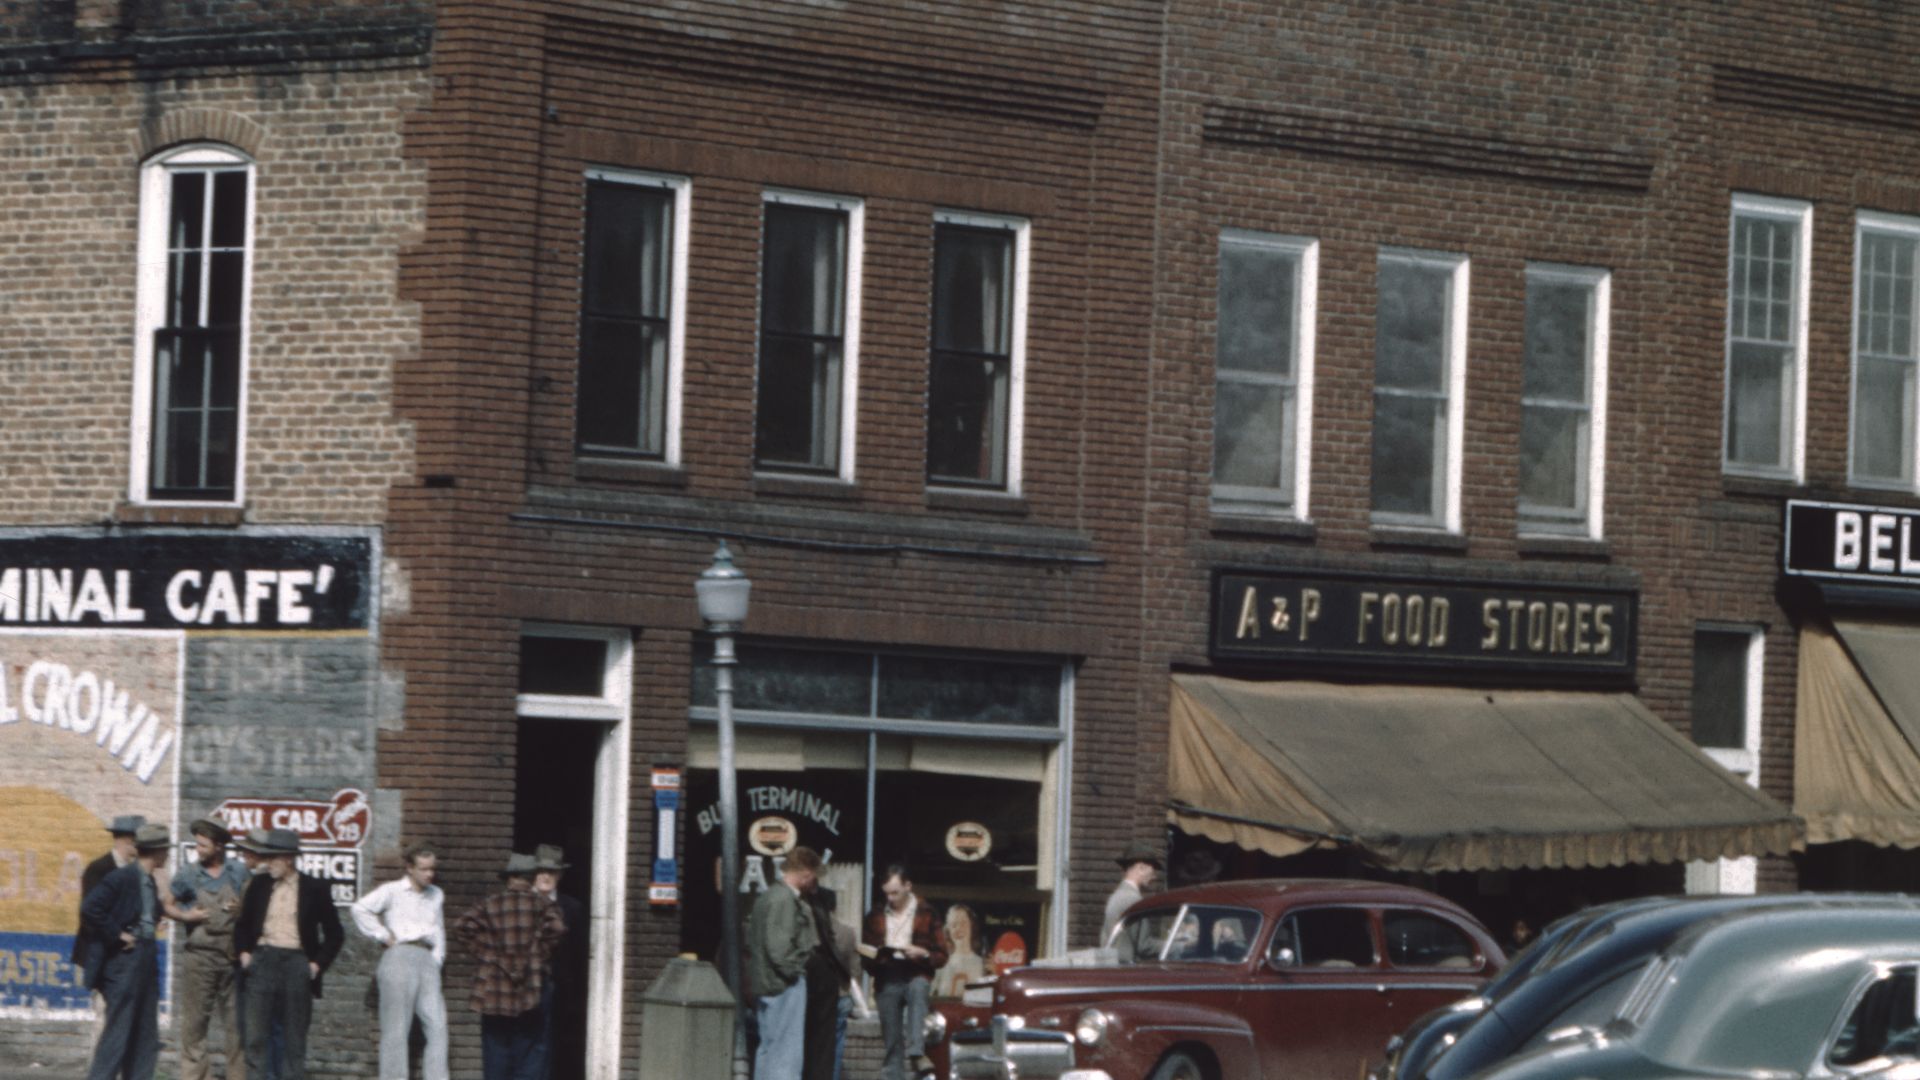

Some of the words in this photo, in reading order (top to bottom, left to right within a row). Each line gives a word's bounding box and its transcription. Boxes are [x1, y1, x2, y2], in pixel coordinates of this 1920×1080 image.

[1834, 511, 1920, 574] BEL
[1357, 592, 1450, 647] FOOD
[1481, 598, 1614, 655] STORES
[22, 659, 174, 784] CROWN
[186, 724, 365, 779] OYSTERS
[220, 806, 263, 832] TAXI
[271, 808, 319, 834] CAB
[747, 785, 841, 836] TERMINAL
